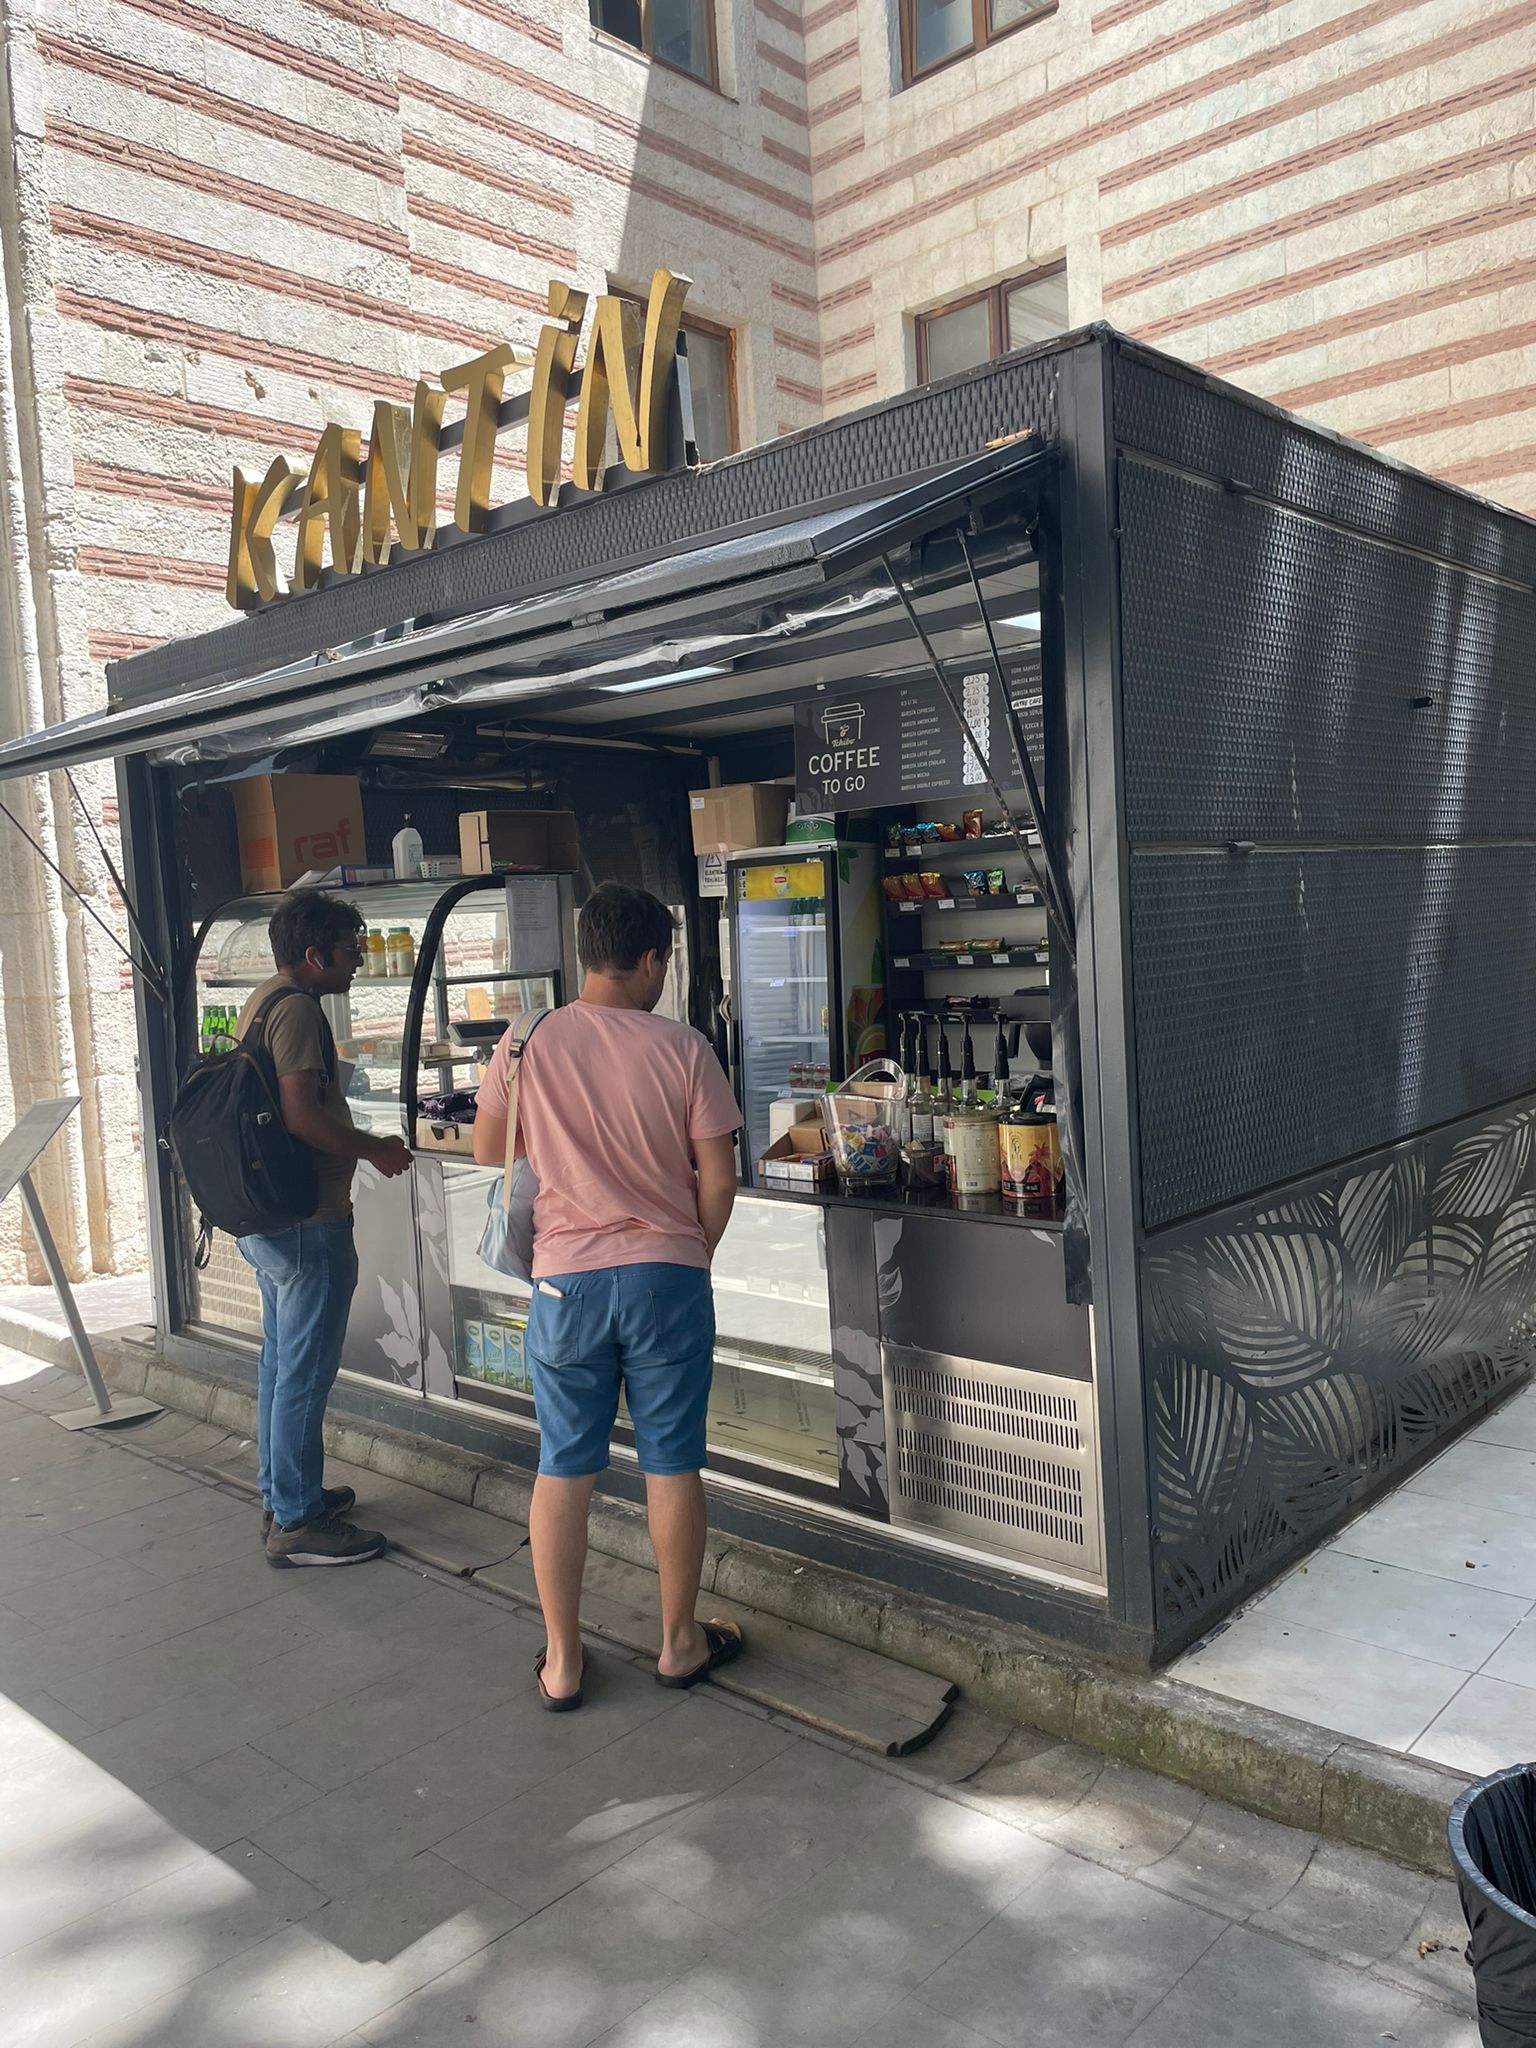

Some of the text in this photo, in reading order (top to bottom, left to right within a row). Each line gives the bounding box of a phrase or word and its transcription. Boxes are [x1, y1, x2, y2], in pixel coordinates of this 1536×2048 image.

[808, 746, 880, 775] COFFEE
[822, 775, 865, 795] TO GO
[293, 817, 352, 864] raf
